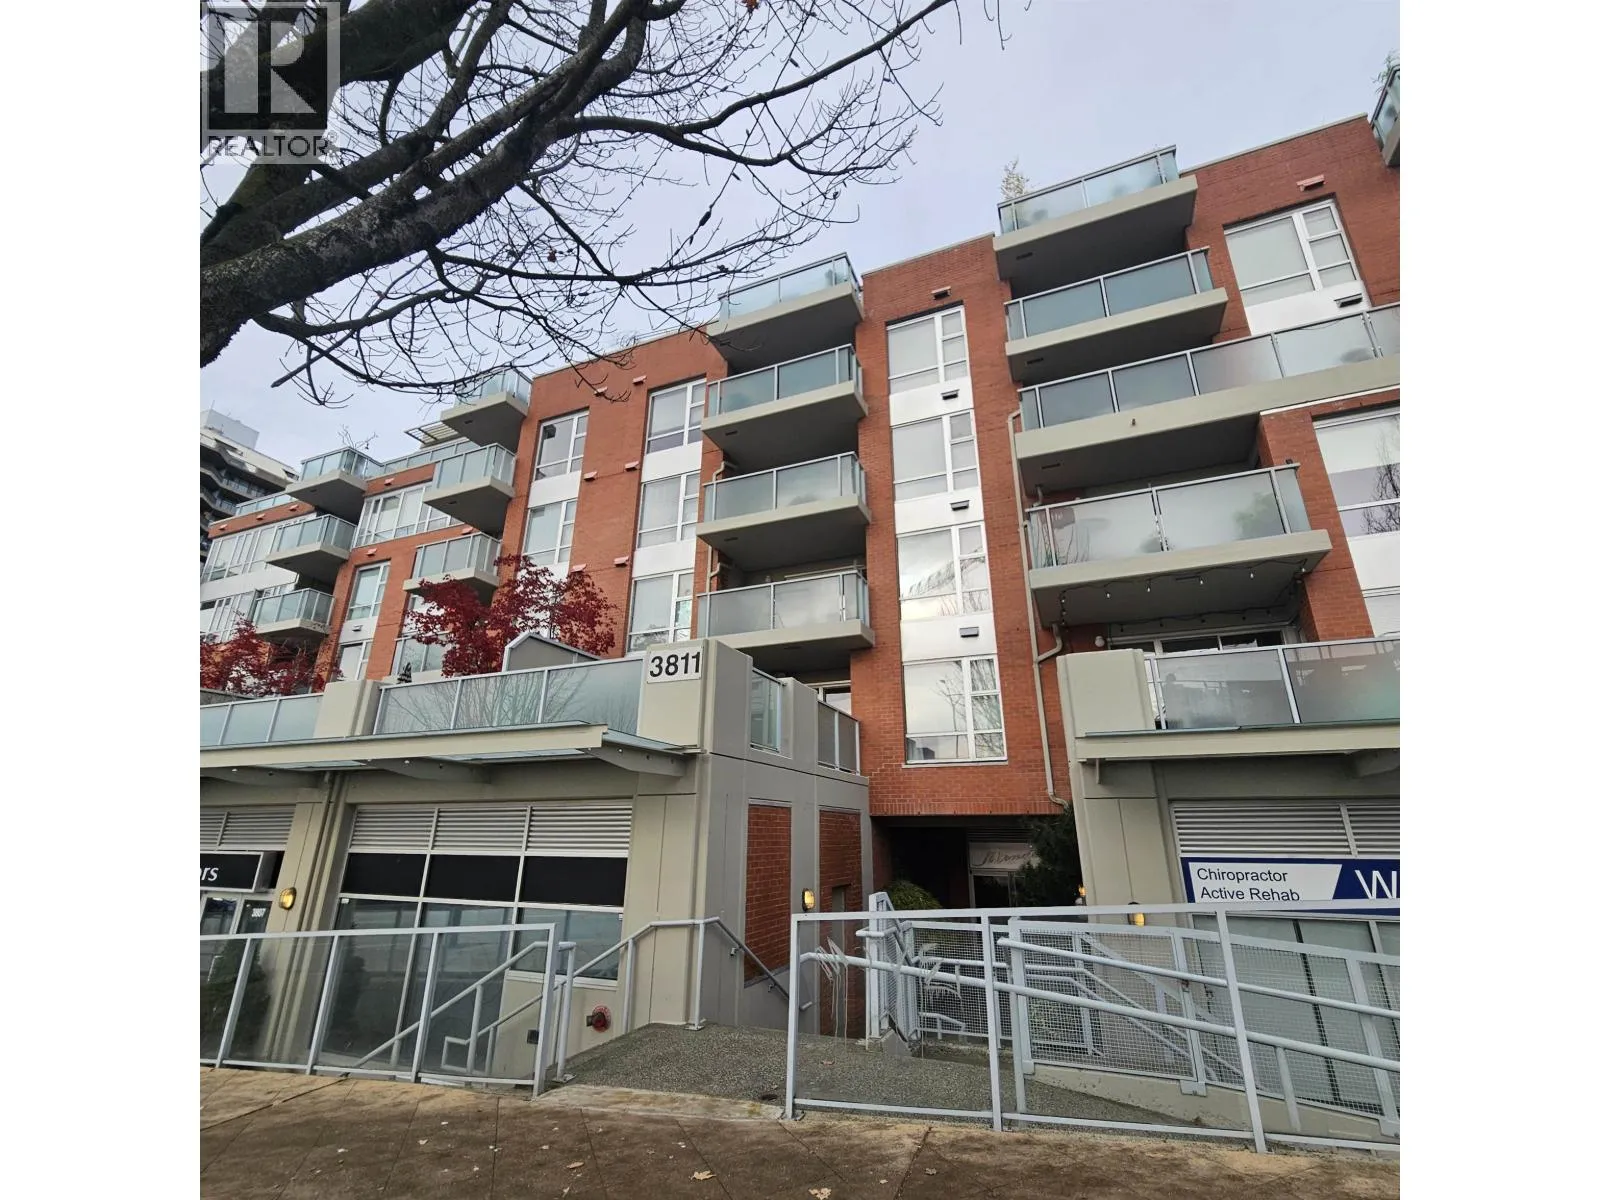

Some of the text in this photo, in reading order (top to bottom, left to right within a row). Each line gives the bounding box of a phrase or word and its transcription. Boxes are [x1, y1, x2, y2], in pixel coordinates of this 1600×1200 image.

[650, 651, 701, 678] 3811
[200, 867, 219, 882] rs
[1197, 868, 1288, 883] Chiropractor
[1200, 887, 1300, 901] Active Rehab
